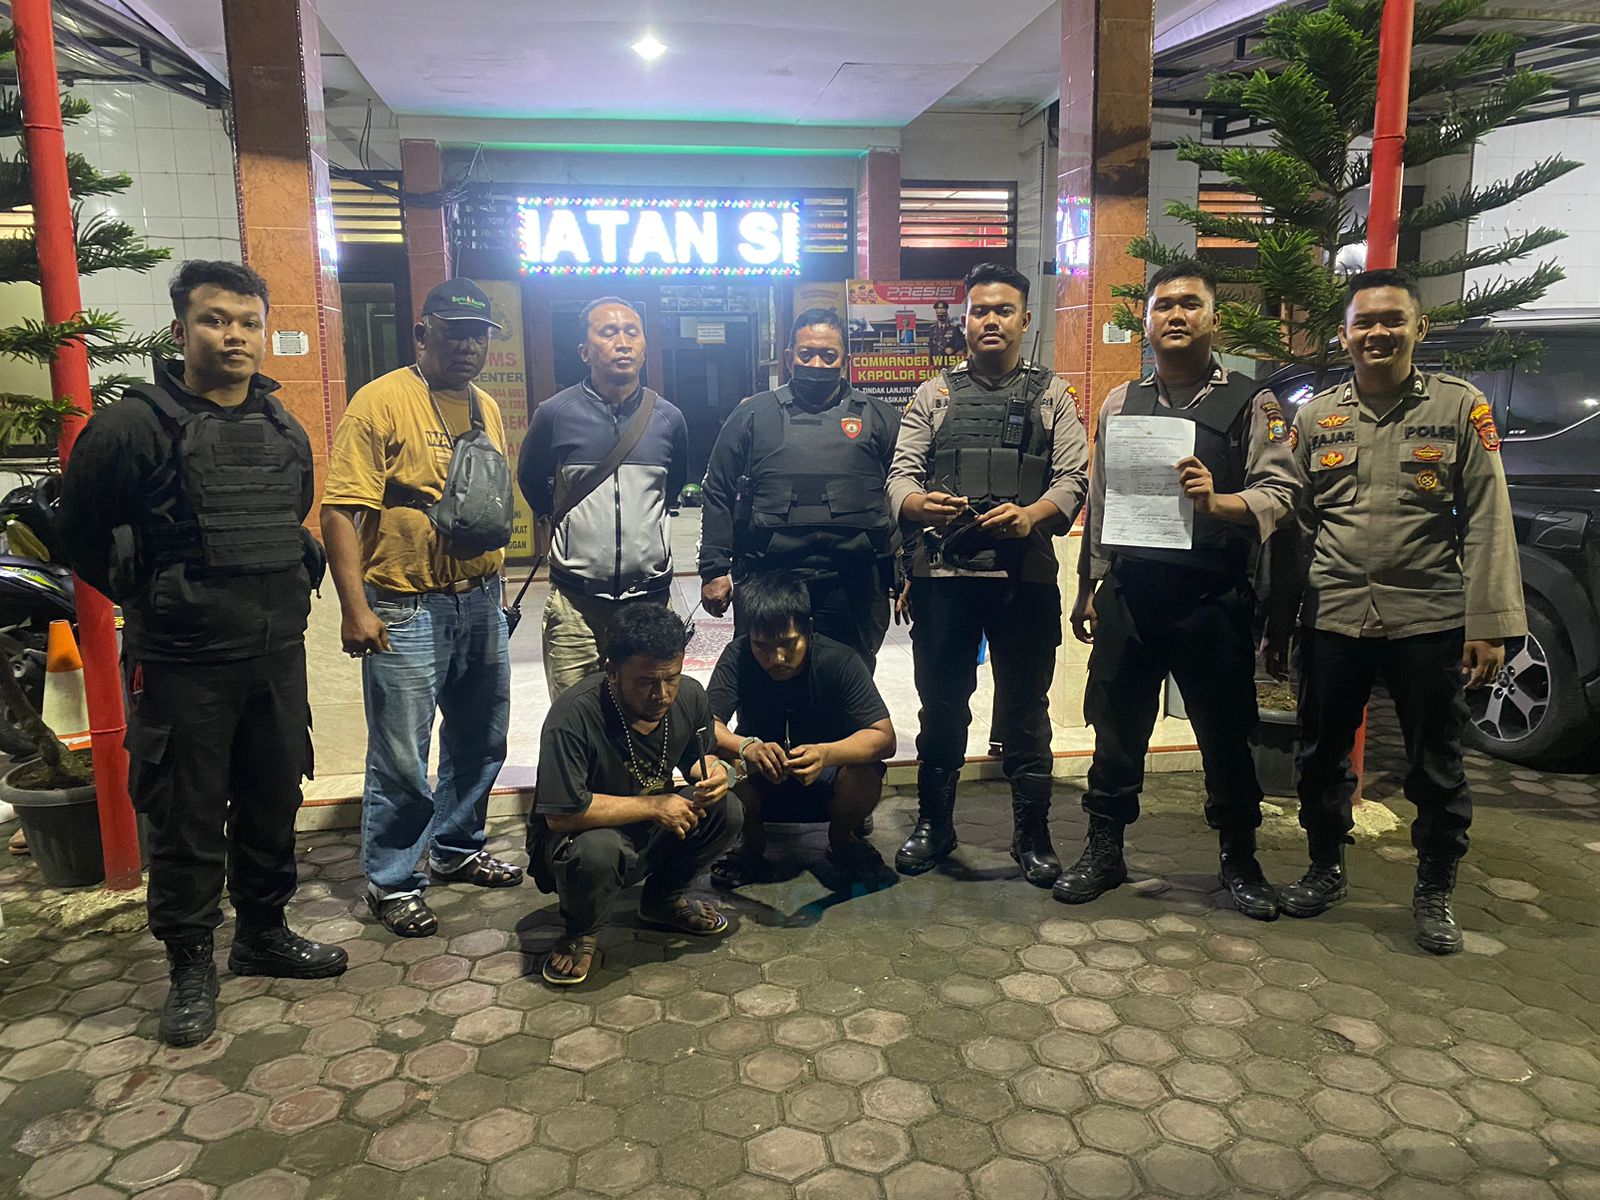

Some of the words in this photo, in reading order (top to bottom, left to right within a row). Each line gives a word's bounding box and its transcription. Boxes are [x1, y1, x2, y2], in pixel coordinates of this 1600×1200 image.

[886, 286, 957, 297] PRESISI
[852, 356, 930, 367] COMMANDER
[858, 369, 916, 381] KAPOLDA
[1404, 425, 1456, 441] POLRI
